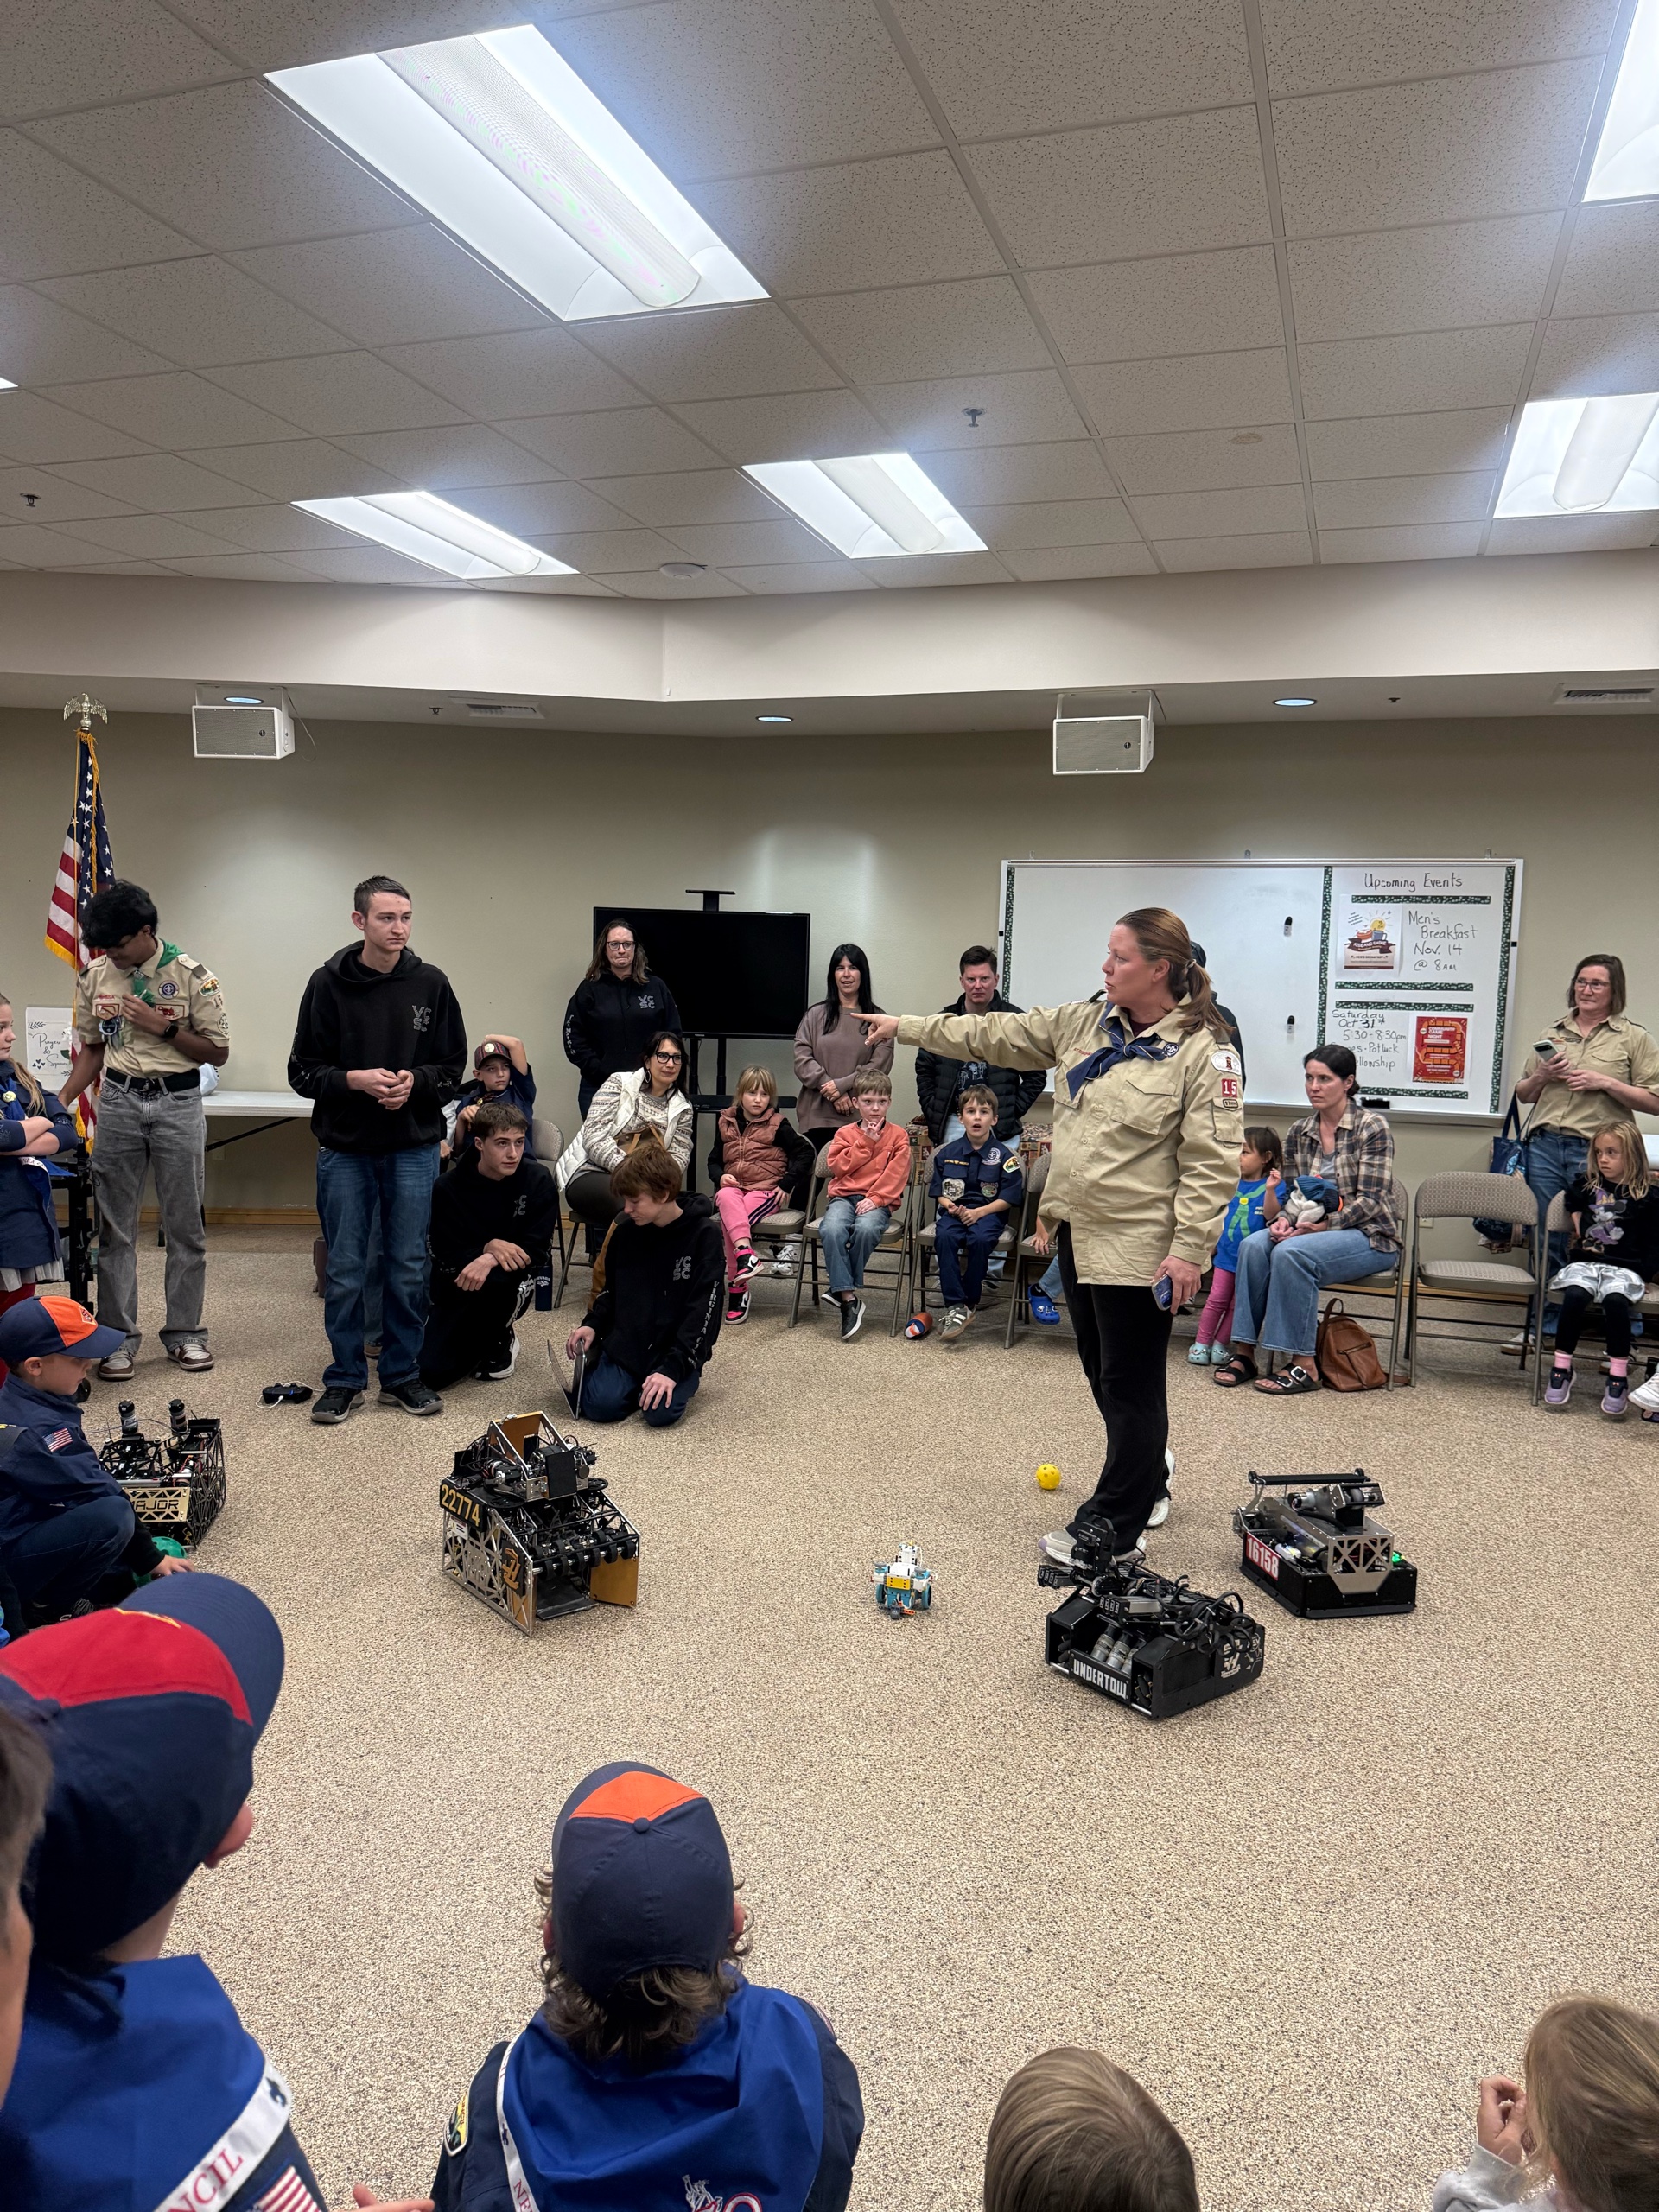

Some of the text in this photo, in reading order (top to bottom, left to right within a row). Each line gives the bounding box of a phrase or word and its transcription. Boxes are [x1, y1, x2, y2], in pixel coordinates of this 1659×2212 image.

[1363, 872, 1463, 892] Upcoming Events
[1408, 910, 1440, 925] Men's
[1421, 923, 1478, 940] Breakfast
[1414, 940, 1462, 956] Nov. 14
[1413, 959, 1428, 971] @
[1332, 1008, 1385, 1020] Saturday
[1338, 1018, 1358, 1028] Oct
[1224, 1080, 1236, 1095] 15
[673, 1268, 691, 1281] SC
[701, 1281, 720, 1335] VIRGINIA
[442, 1484, 480, 1527] 22774
[1247, 1537, 1279, 1580] 16158
[1072, 1658, 1128, 1699] UNDERTOW
